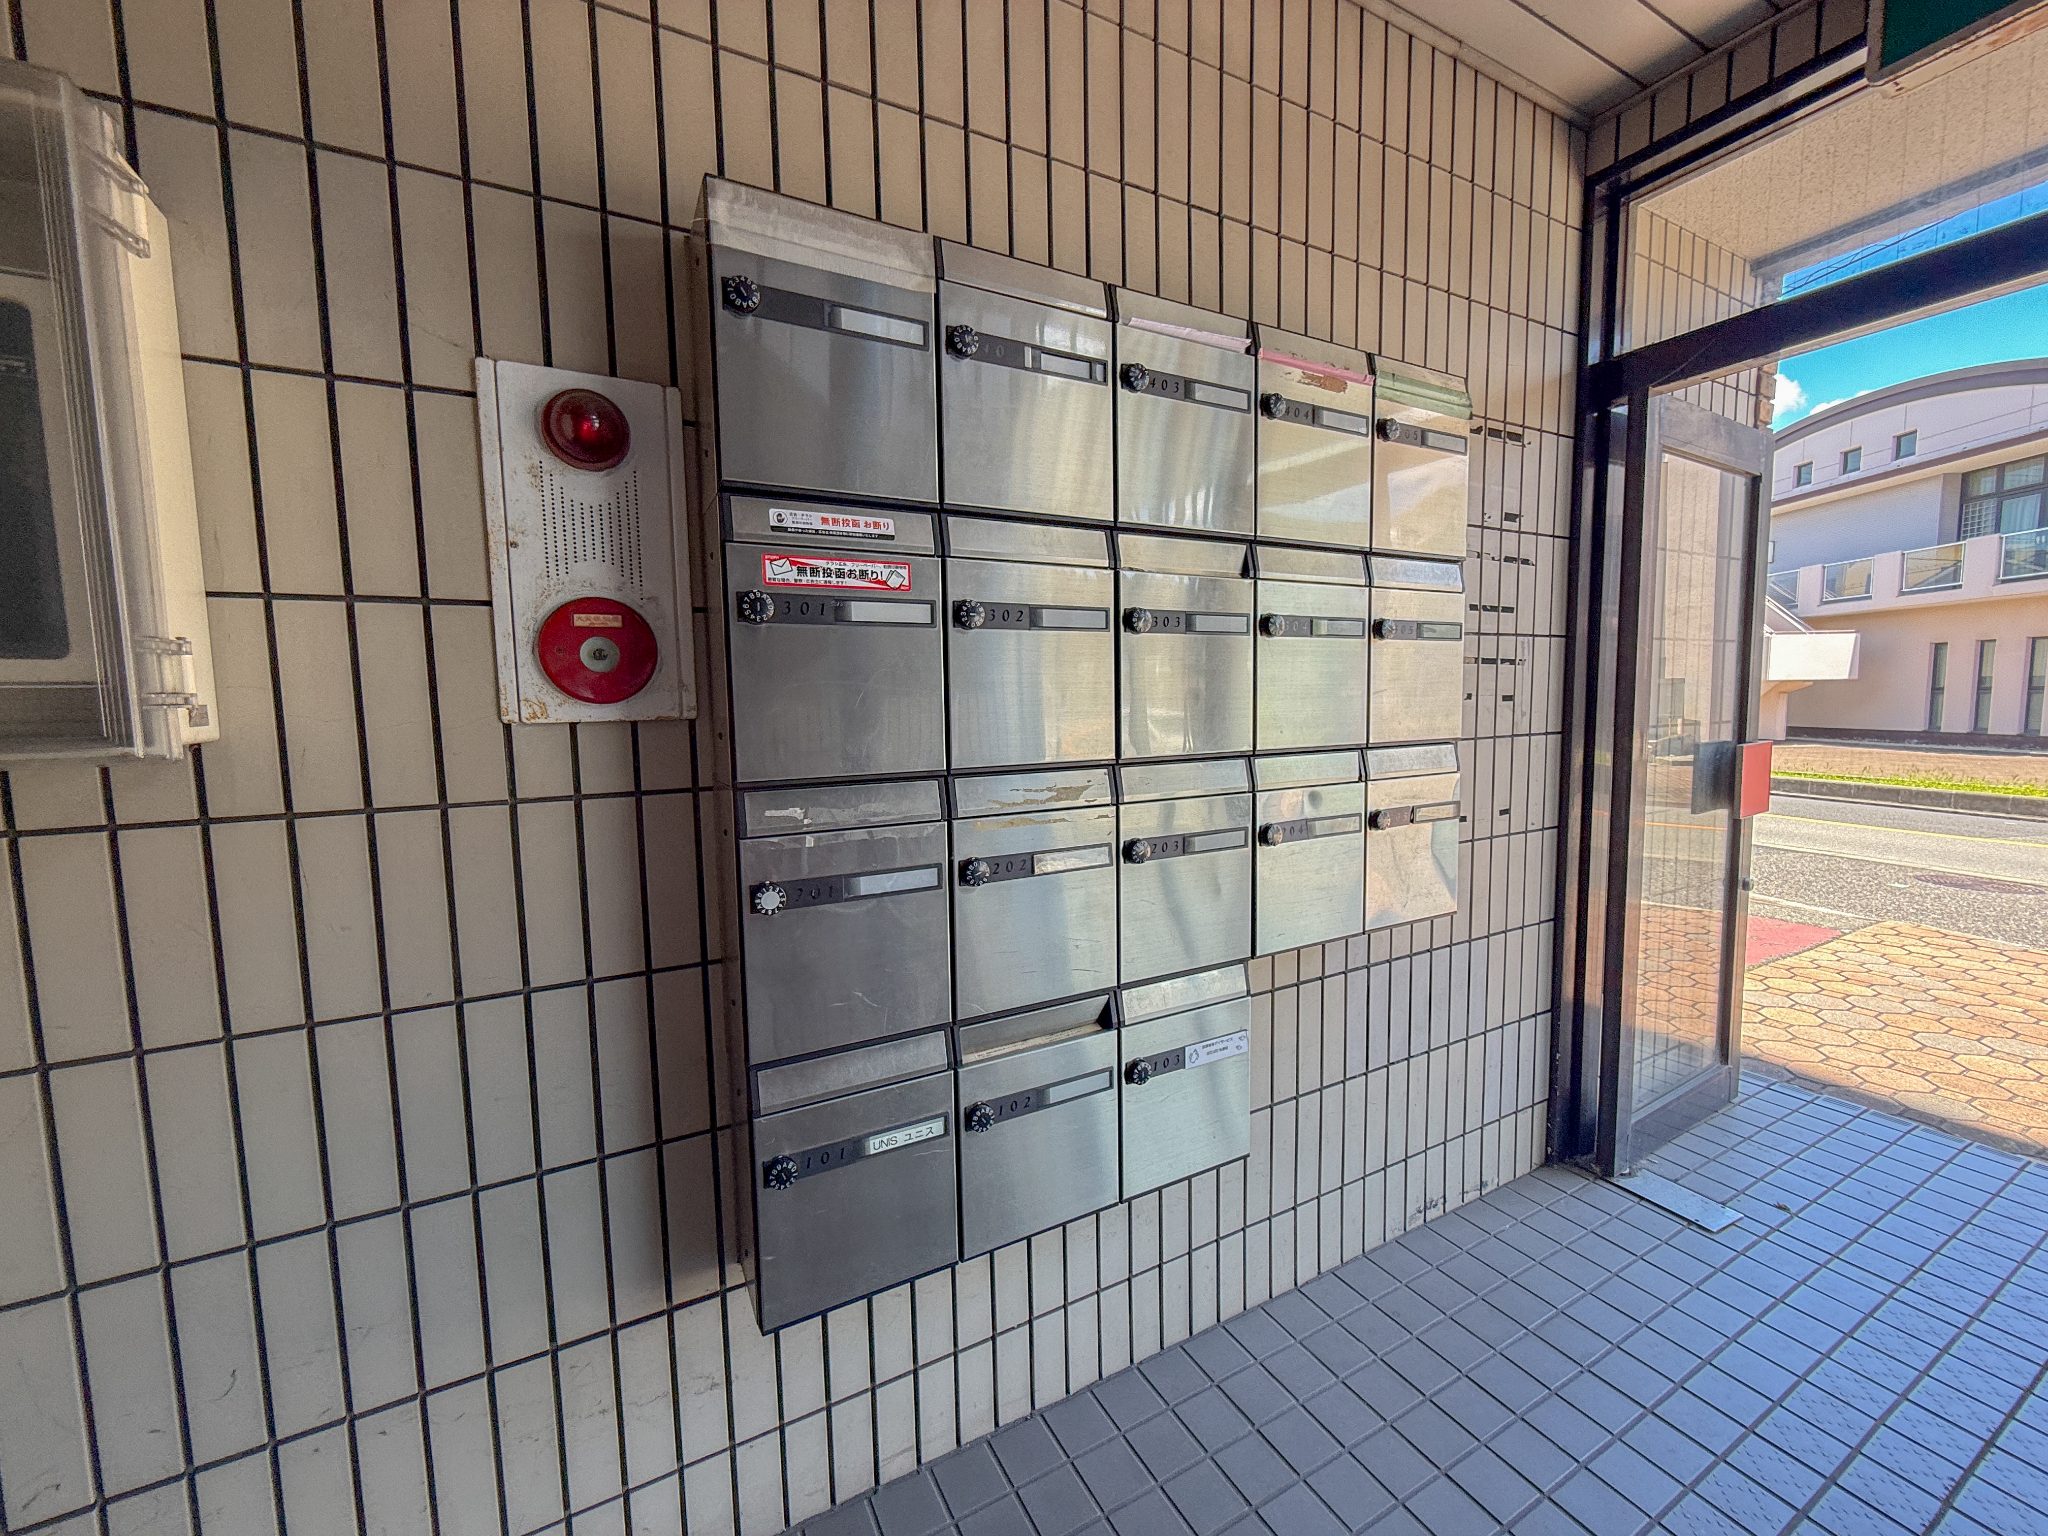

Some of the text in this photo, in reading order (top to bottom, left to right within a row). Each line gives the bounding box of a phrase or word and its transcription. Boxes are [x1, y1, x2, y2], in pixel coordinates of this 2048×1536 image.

[1149, 377, 1179, 393] 403
[820, 516, 861, 529] 無断投函
[863, 520, 890, 531] お断り
[796, 566, 884, 581] 無断投函お断り!
[782, 600, 826, 616] 301
[988, 609, 1024, 622] 302
[1152, 616, 1181, 627] 303
[1151, 840, 1179, 854] 203
[992, 859, 1027, 875] 202
[1153, 1054, 1180, 1071] 103
[999, 1096, 1031, 1116] 102
[903, 1127, 935, 1142] ユニス
[806, 1147, 845, 1169] 101
